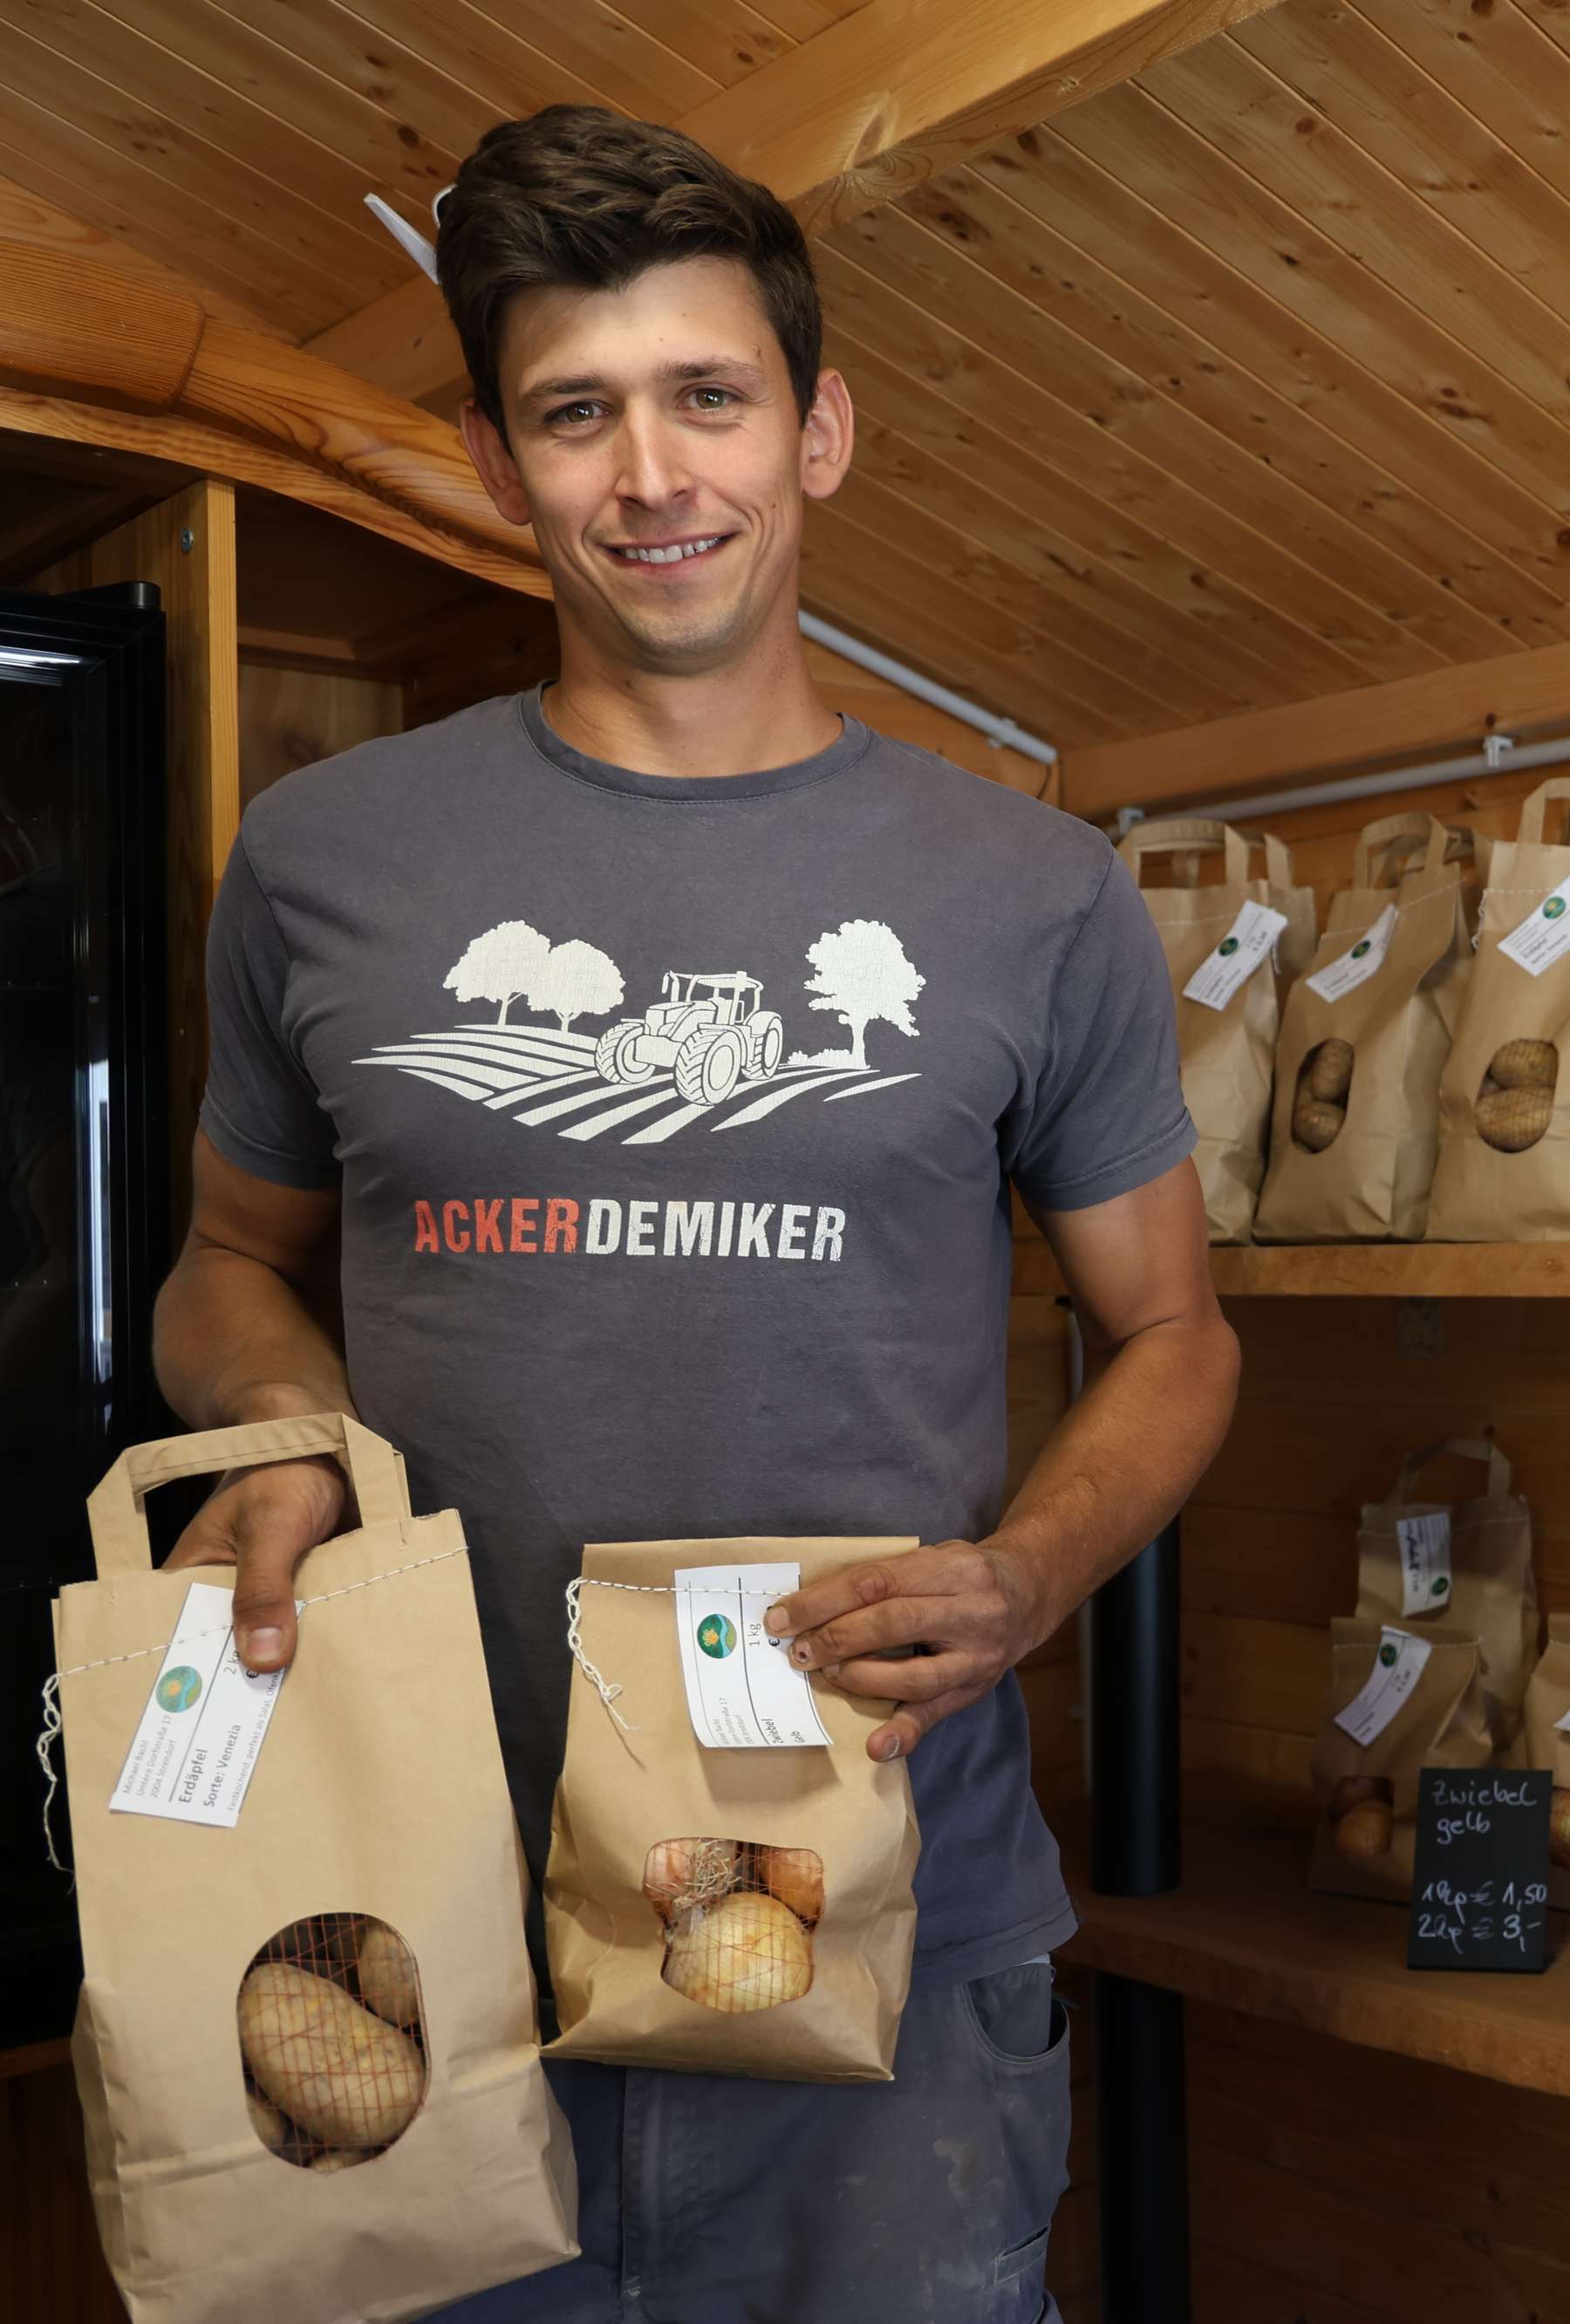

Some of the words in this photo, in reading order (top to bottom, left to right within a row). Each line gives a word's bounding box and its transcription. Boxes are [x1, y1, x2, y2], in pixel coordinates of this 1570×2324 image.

[414, 1198, 846, 1261] ACKERDEMIKER
[748, 1623, 761, 1637] kg
[768, 1638, 781, 1647] €
[223, 1665, 236, 1675] 2
[761, 1718, 784, 1744] Zwiebel
[788, 1731, 805, 1743] Gelb
[179, 1748, 208, 1804] Erdäpfel
[203, 1771, 222, 1808] Sorte:
[218, 1724, 242, 1769] Venezia
[1431, 1779, 1537, 1806] Zwiebel
[1437, 1810, 1491, 1845] gelb
[1502, 1882, 1547, 1912] 1,50
